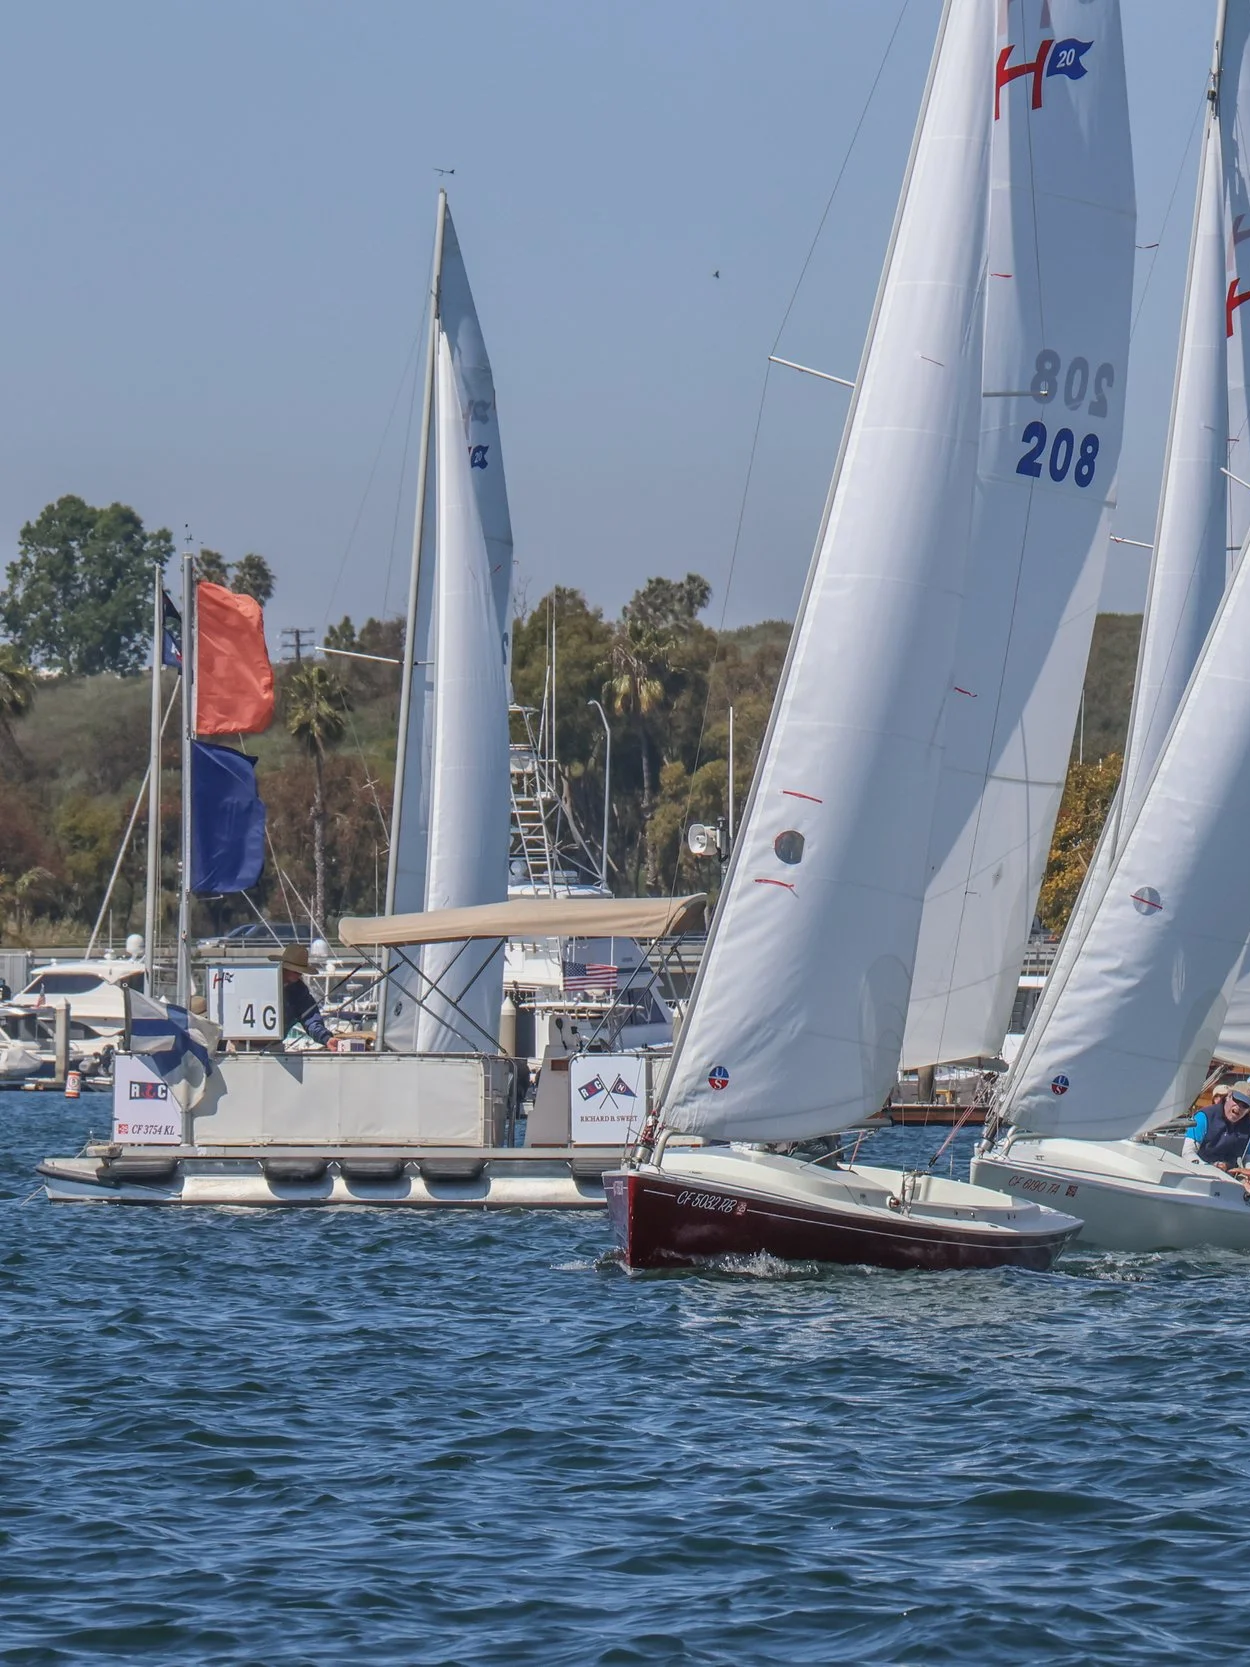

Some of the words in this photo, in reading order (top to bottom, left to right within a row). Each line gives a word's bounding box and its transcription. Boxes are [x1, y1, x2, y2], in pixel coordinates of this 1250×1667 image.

[994, 39, 1055, 121] H
[1056, 48, 1076, 69] 20
[1016, 421, 1100, 488] 208
[131, 1124, 143, 1135] CF
[143, 1124, 162, 1136] 3754
[163, 1125, 175, 1136] KL
[1008, 1175, 1025, 1187] CF
[1047, 1183, 1061, 1196] TA
[677, 1191, 696, 1206] CF
[692, 1193, 721, 1211] 5032
[718, 1199, 738, 1214] RB
